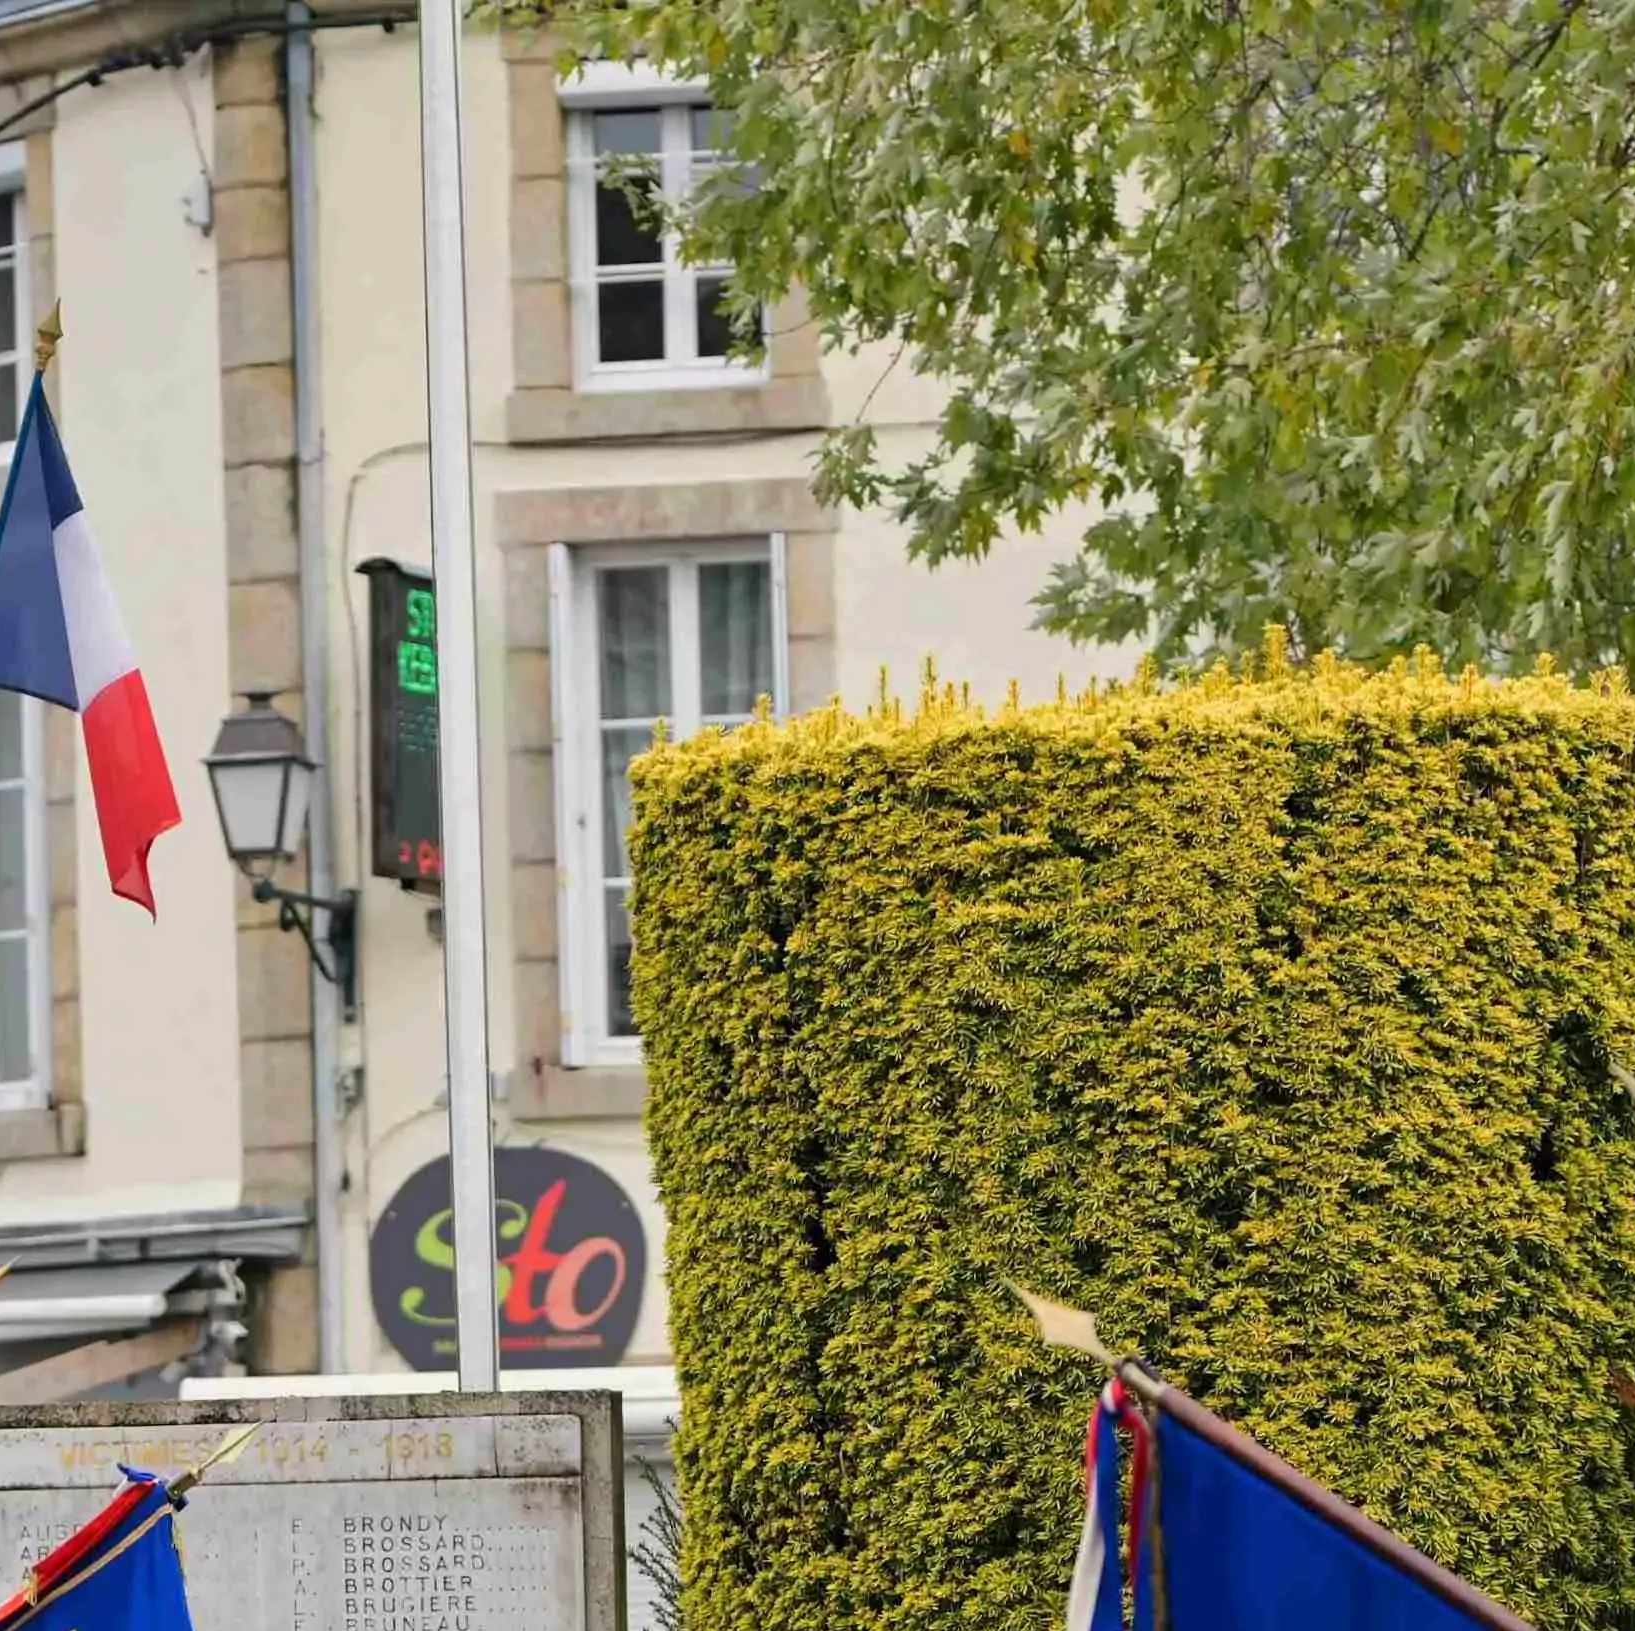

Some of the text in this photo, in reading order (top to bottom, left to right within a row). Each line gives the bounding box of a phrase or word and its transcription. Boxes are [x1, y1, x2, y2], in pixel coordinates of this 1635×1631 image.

[400, 1177, 626, 1331] Sto
[343, 1515, 448, 1534] BRONDY
[344, 1535, 485, 1553] BROSSARD
[344, 1555, 485, 1574] BROSSARD
[344, 1576, 473, 1594] BROTTIER
